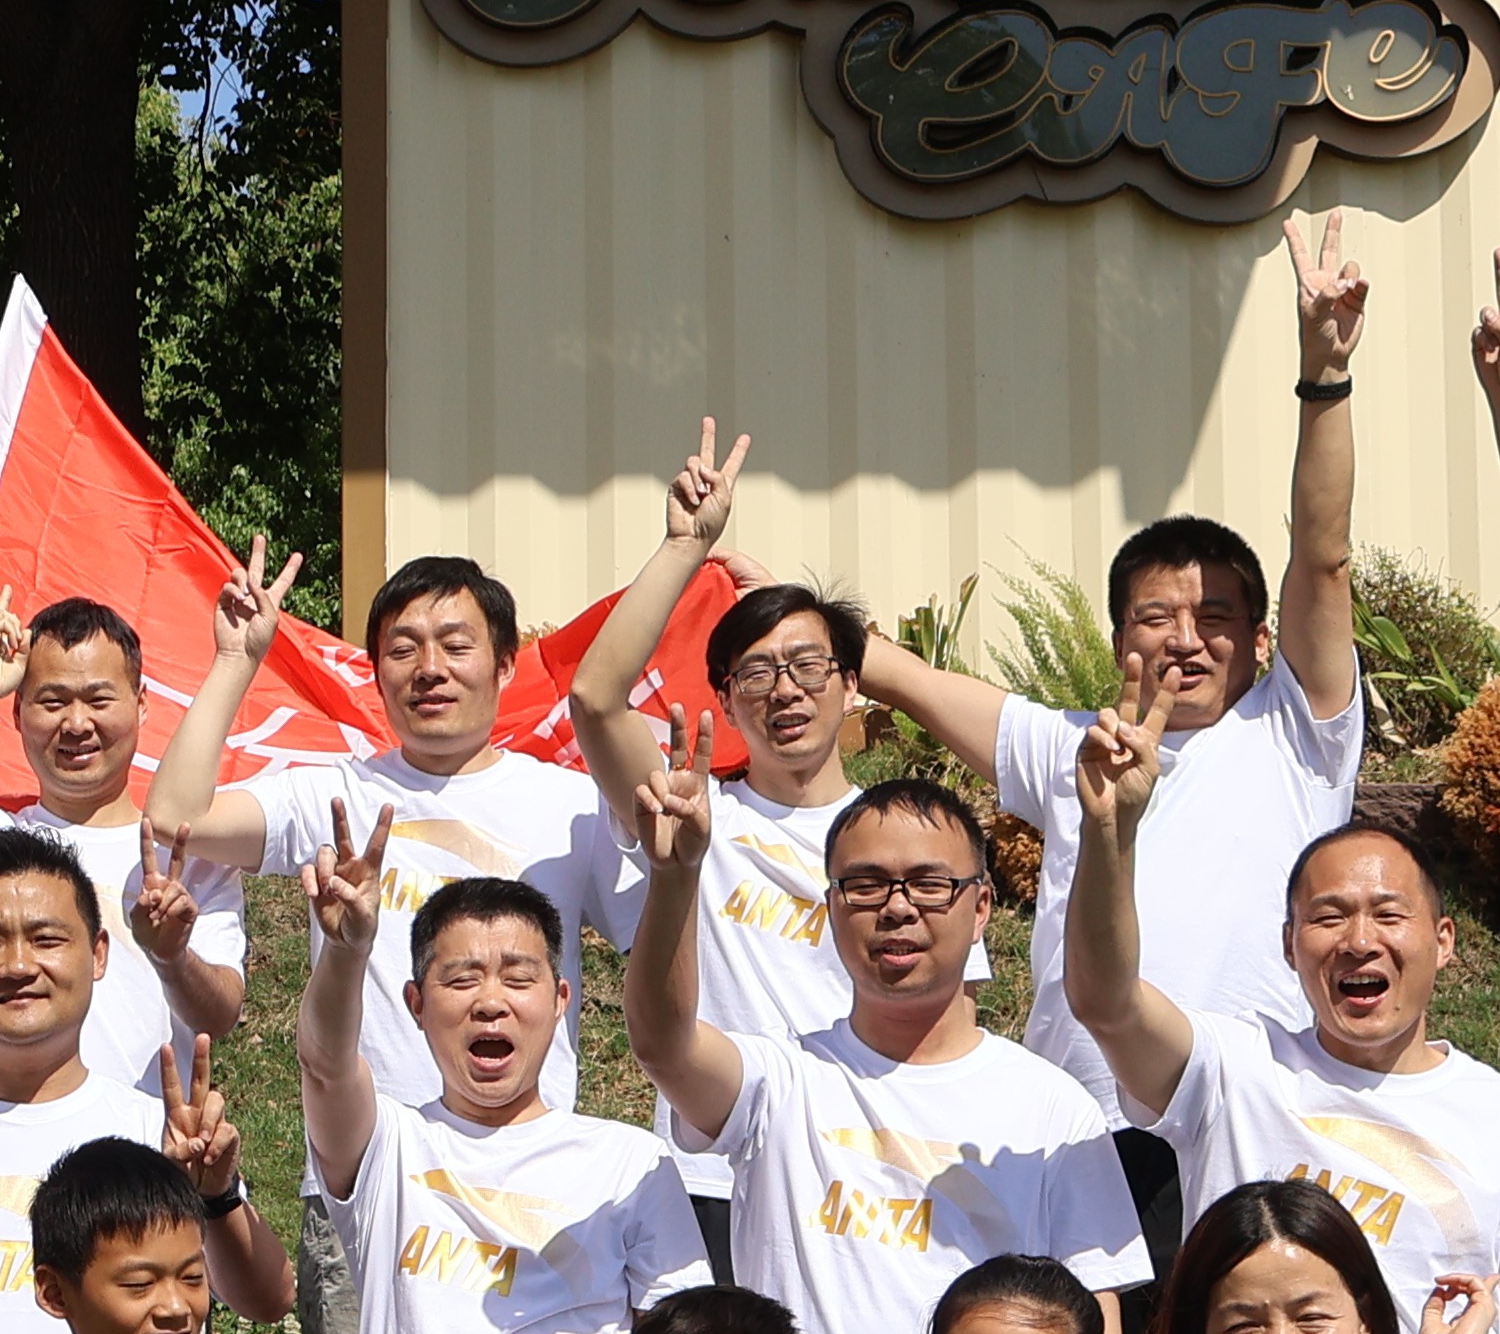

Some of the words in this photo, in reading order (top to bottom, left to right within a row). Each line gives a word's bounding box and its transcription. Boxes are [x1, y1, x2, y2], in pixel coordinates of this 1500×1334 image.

[718, 879, 827, 948] ANTA
[809, 1180, 933, 1252] ANTA
[399, 1224, 517, 1297] ANTA
